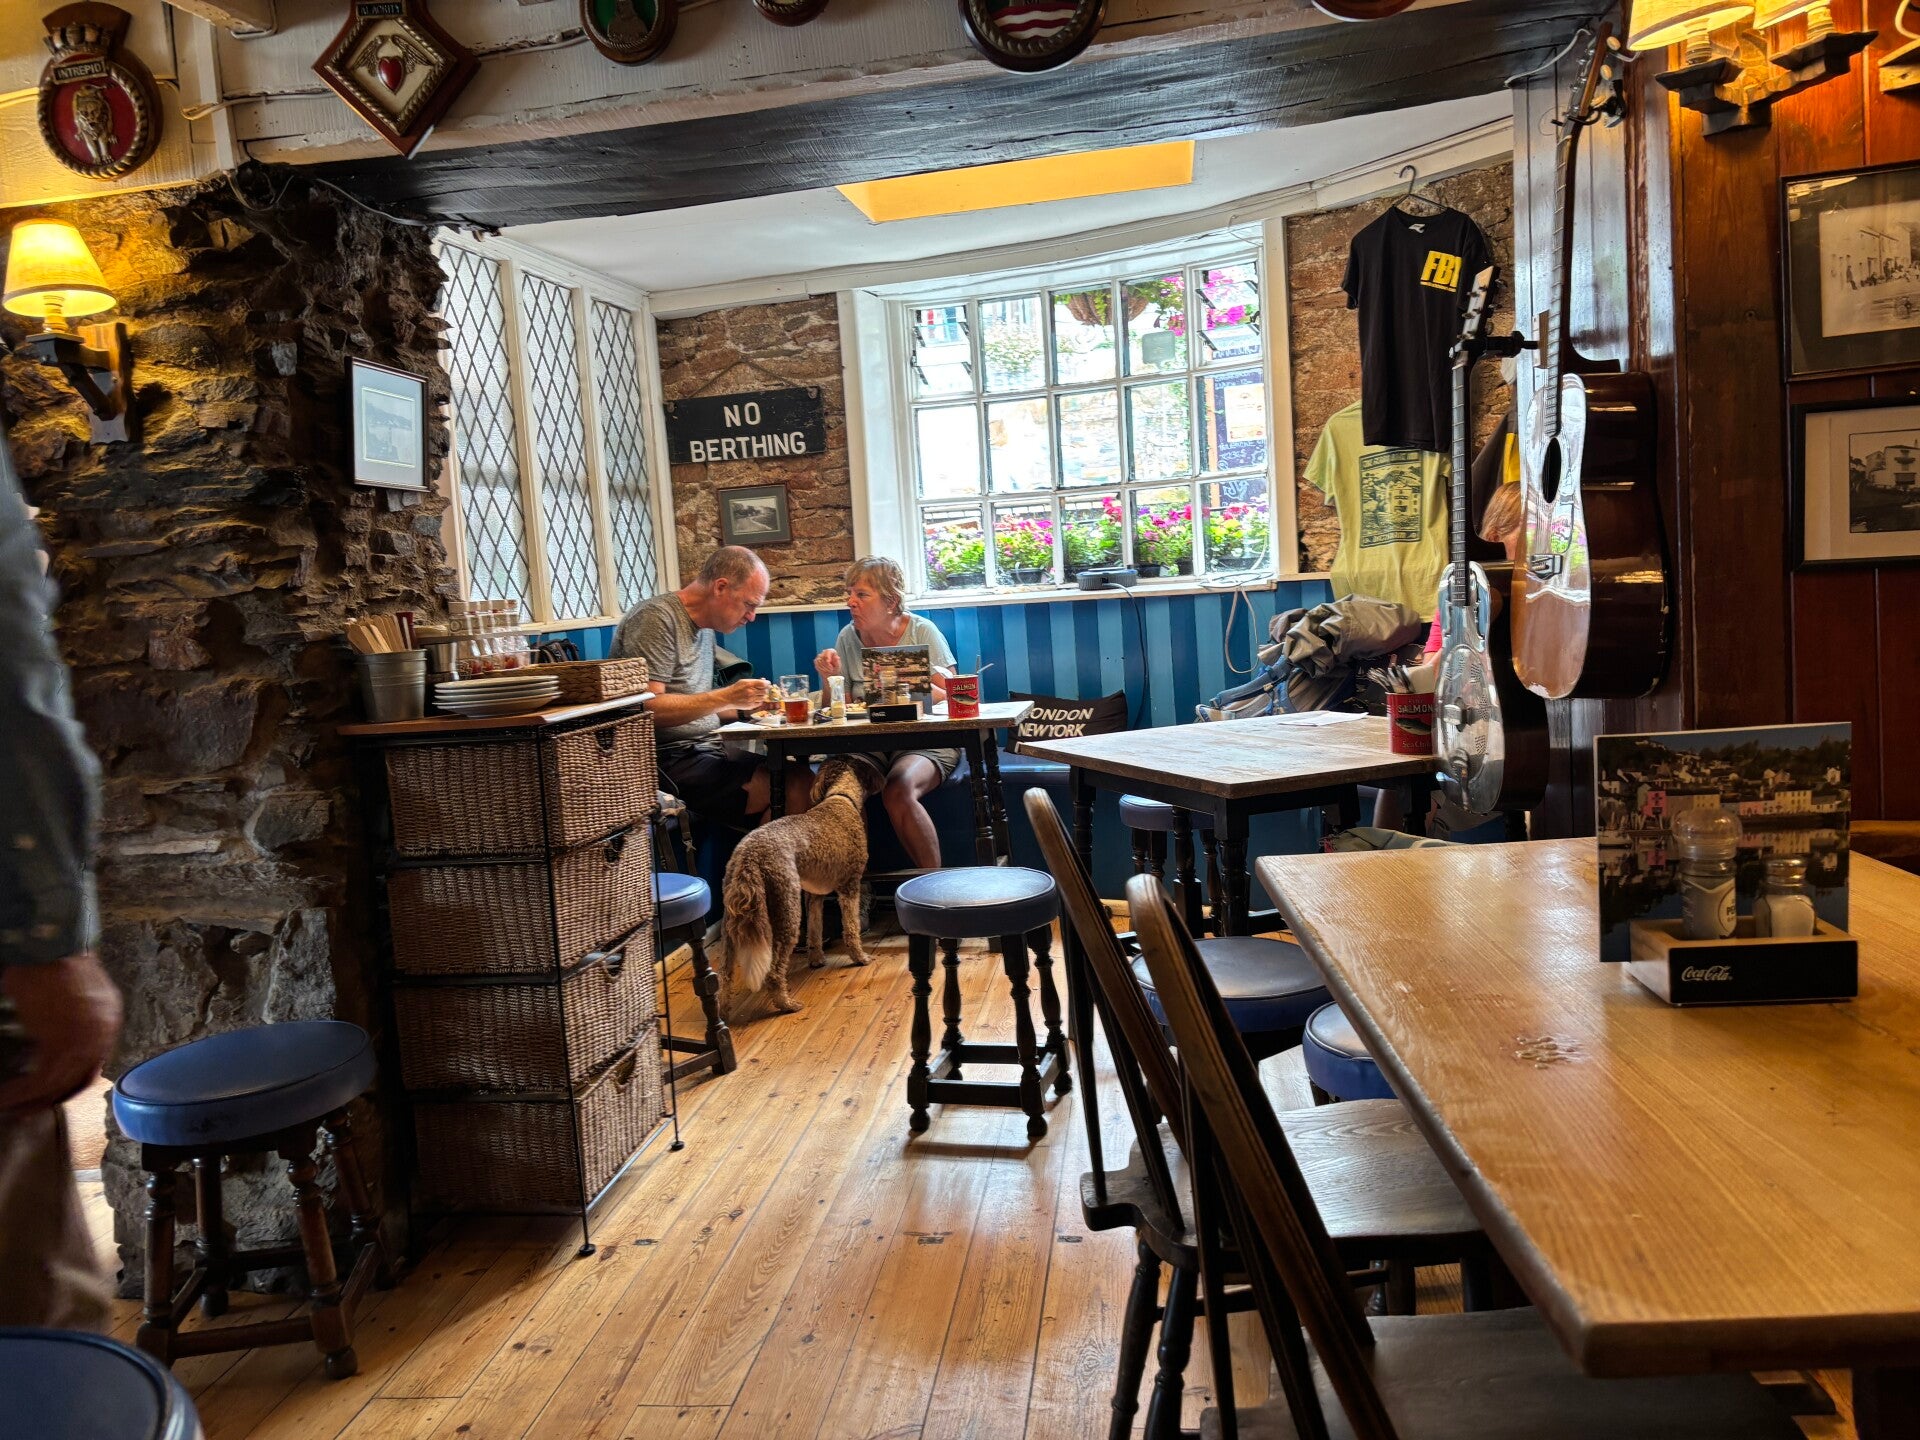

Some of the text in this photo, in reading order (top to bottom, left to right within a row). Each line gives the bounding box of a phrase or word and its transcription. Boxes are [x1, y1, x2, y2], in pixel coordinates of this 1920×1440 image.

[57, 62, 101, 79] INTREPID
[1421, 250, 1462, 288] FBI
[723, 401, 762, 428] NO
[689, 431, 806, 463] BERTHING
[952, 683, 976, 691] SALMON
[1397, 704, 1433, 714] SALMON
